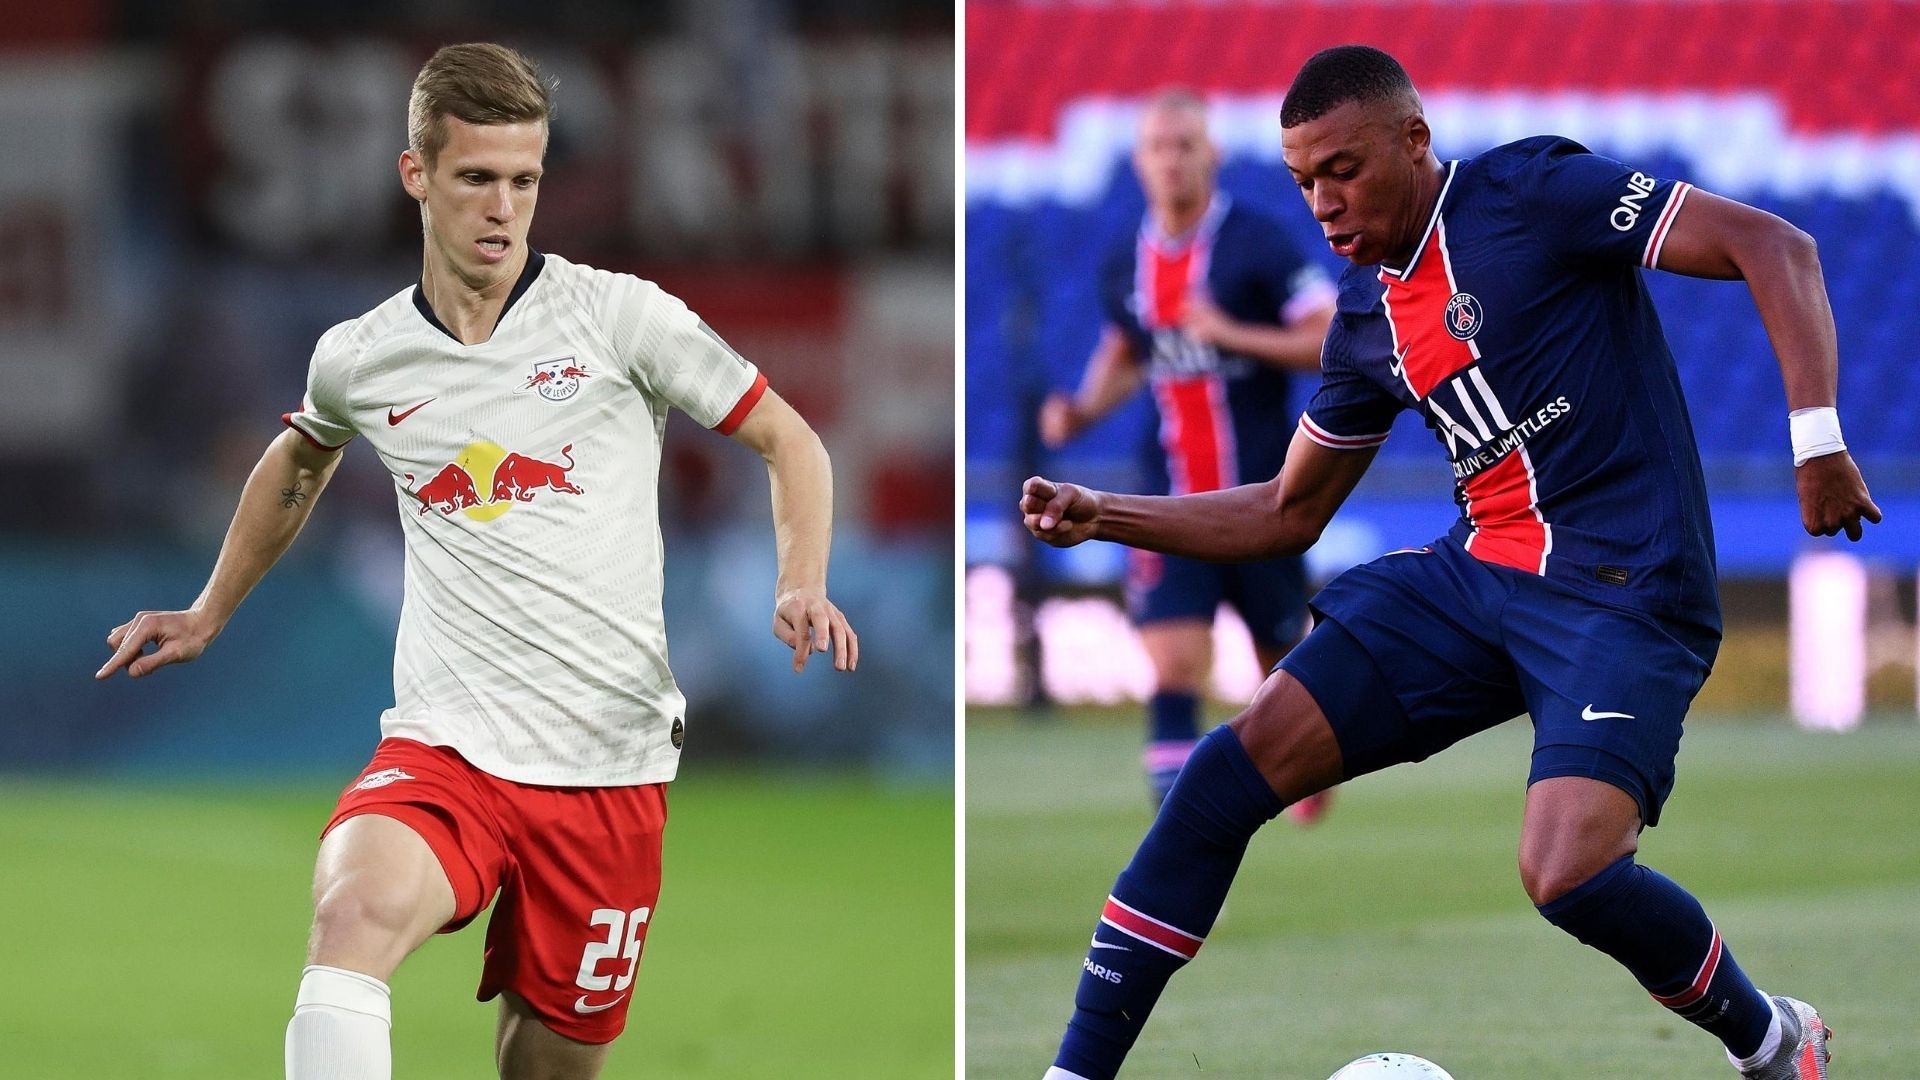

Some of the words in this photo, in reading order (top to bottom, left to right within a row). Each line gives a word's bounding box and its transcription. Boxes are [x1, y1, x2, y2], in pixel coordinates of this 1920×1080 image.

[1610, 171, 1656, 231] QNB
[1448, 296, 1471, 312] PARIS
[553, 382, 576, 397] LEIPZIG
[1461, 452, 1494, 475] LIVE
[1490, 396, 1571, 458] LIMITLESS
[575, 907, 650, 991] 25
[1083, 957, 1123, 984] PARIS
